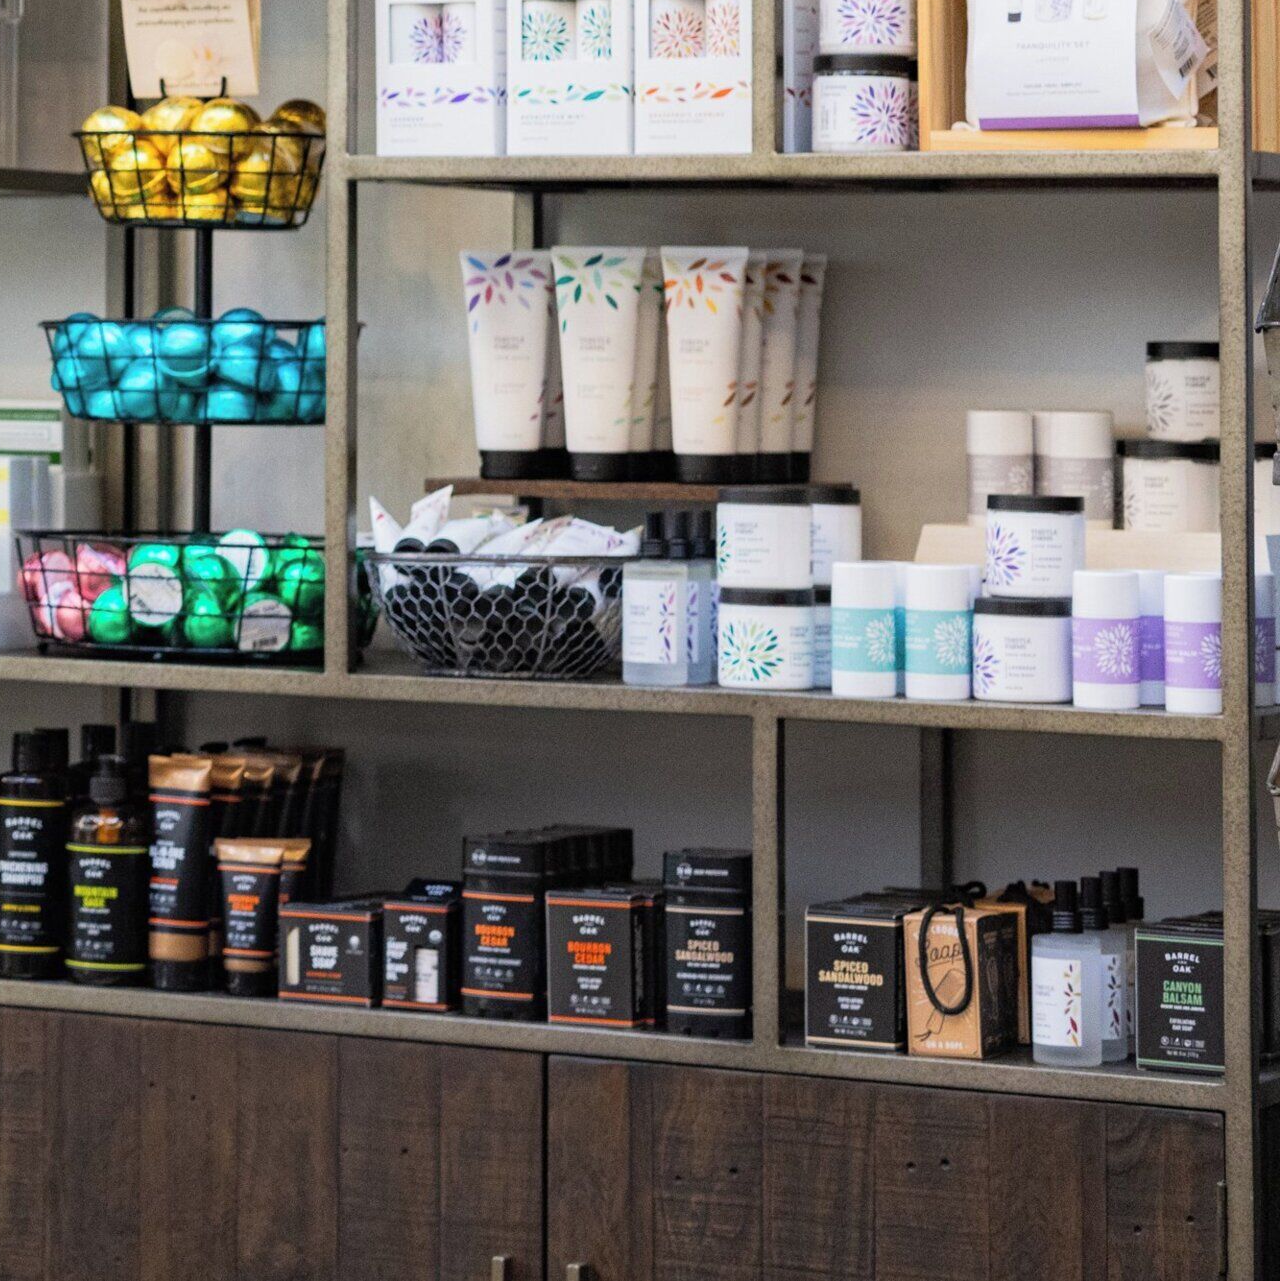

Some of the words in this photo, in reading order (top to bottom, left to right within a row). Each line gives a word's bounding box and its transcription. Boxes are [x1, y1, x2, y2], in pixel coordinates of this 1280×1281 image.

[687, 939, 720, 952] SPICED
[833, 932, 868, 945] BARREL
[567, 940, 612, 955] BOURBON
[841, 944, 860, 954] OAK
[574, 952, 606, 966] CEDAR
[674, 948, 735, 964] SANDALWOOD
[1164, 952, 1200, 964] BARREL
[833, 959, 869, 974] SPICED
[1172, 964, 1192, 974] OAK
[818, 969, 884, 987] SANDALWOOD
[1163, 980, 1202, 995] CANYON
[1162, 991, 1203, 1007] BALSAM
